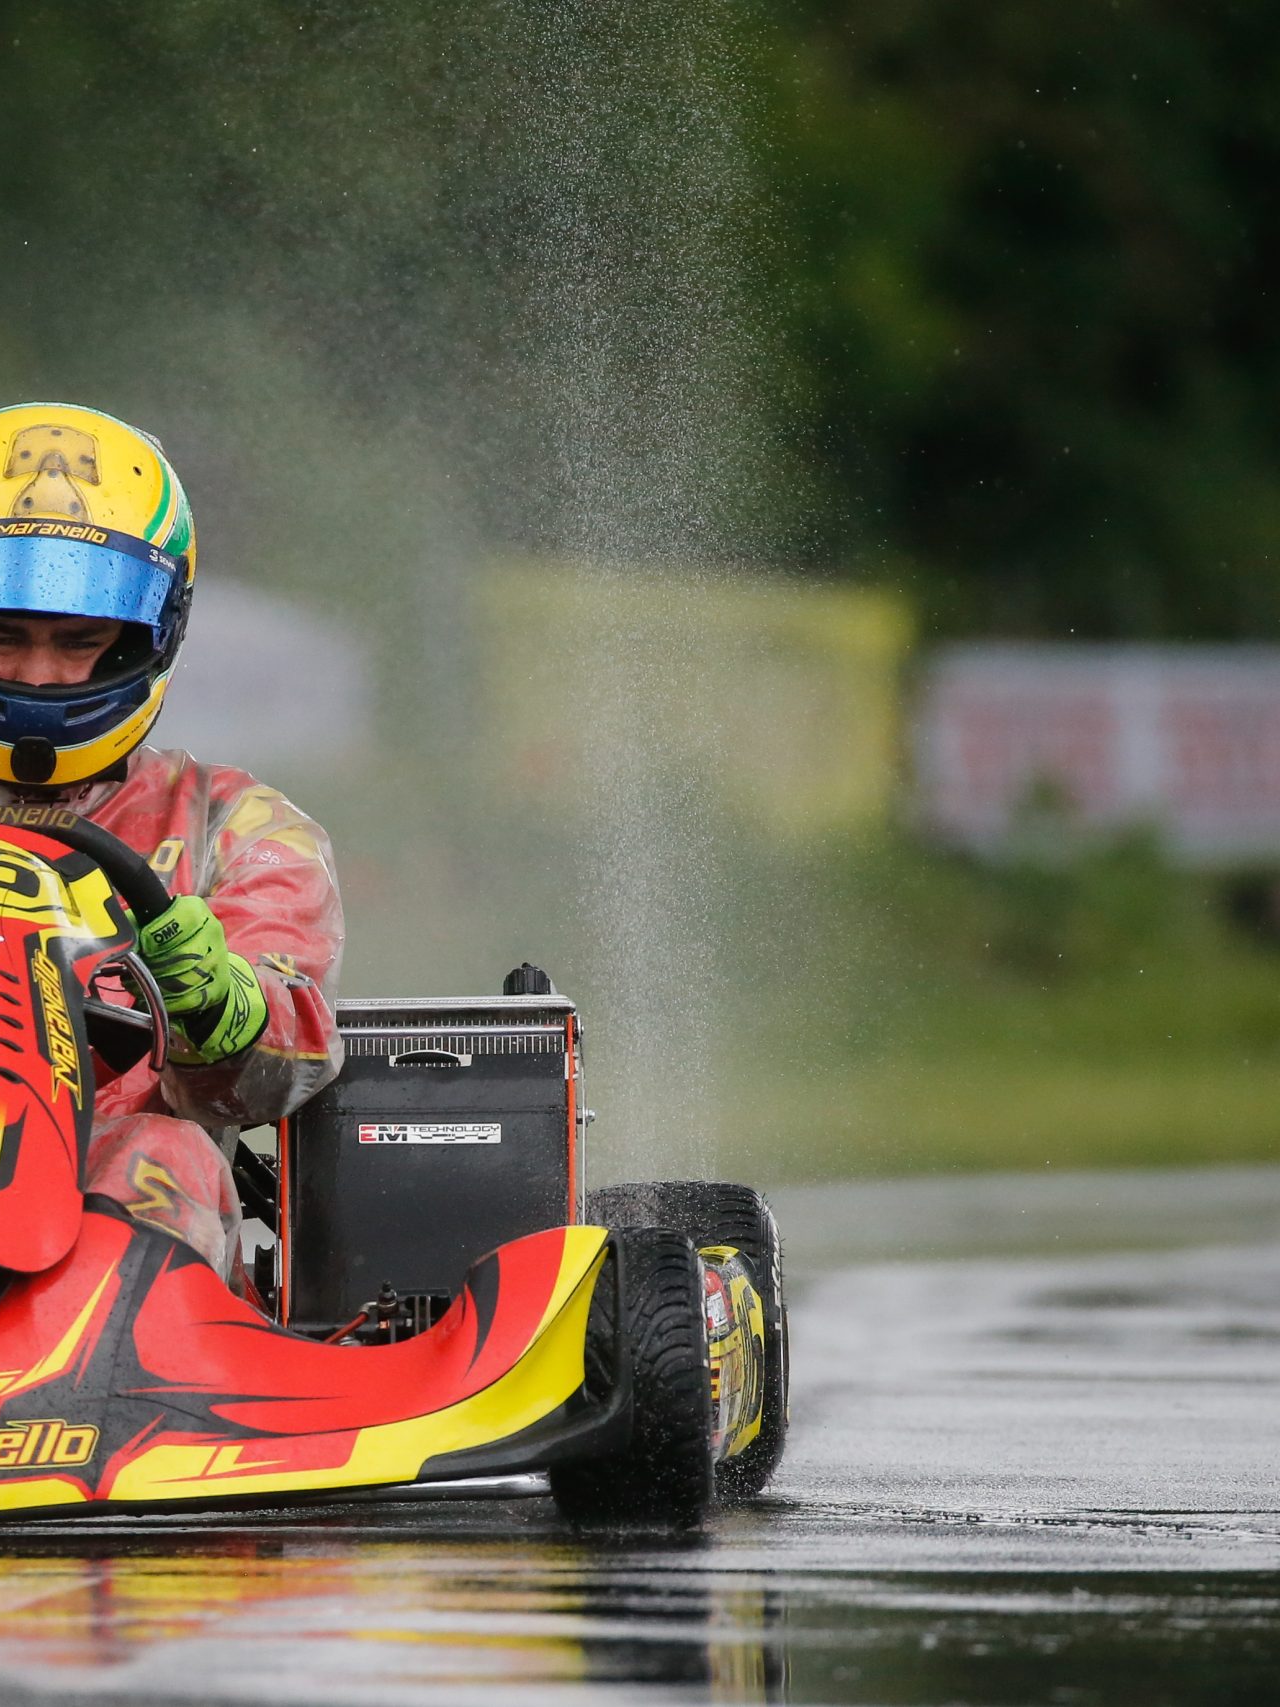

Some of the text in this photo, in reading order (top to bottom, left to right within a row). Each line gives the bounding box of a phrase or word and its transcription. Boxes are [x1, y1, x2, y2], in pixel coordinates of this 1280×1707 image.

[153, 920, 180, 945] OMP
[360, 1125, 500, 1142] EM TECHNOLOGY
